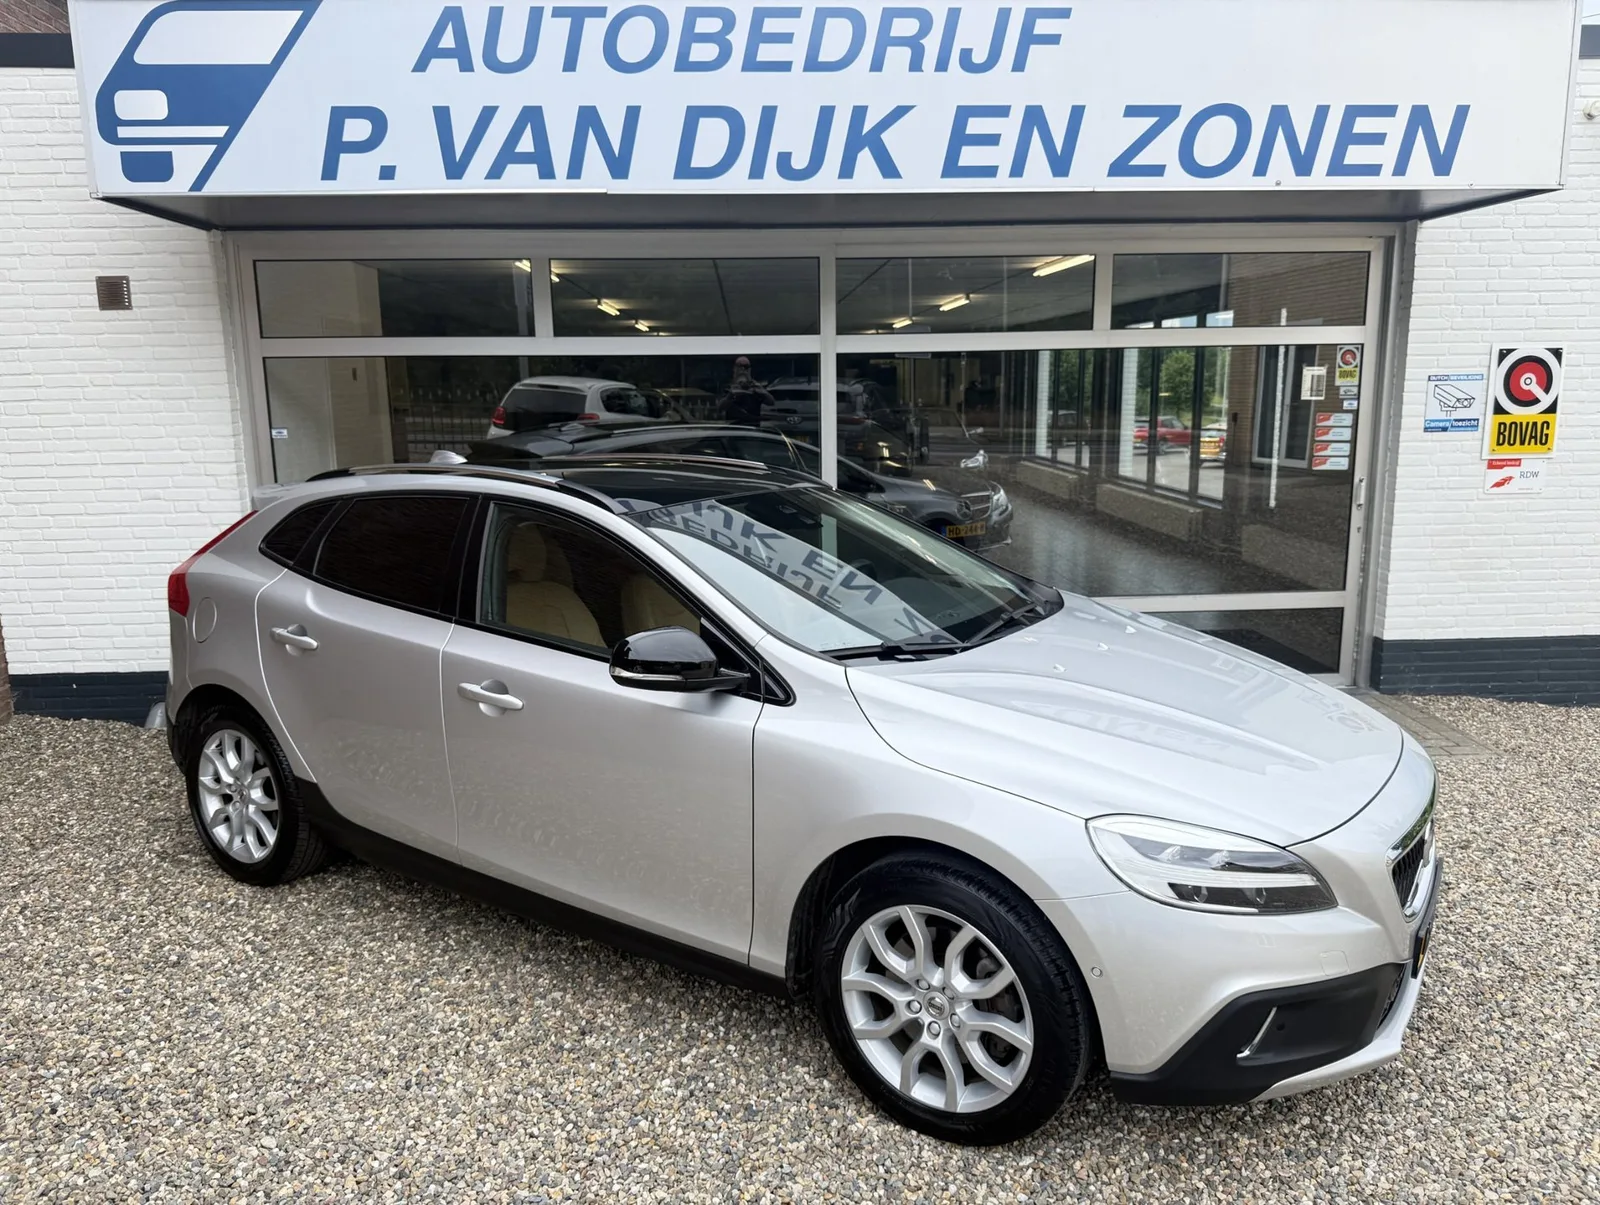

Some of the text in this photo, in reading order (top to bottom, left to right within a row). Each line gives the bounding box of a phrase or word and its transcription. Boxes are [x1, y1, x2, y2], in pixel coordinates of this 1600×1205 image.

[412, 6, 1072, 74] AUTOBEDRIJF
[322, 104, 1469, 182] P. VAN DIJK EN ZONEN
[1425, 419, 1478, 428] Camera toezicht
[1496, 420, 1550, 447] BOVAG
[1519, 470, 1539, 479] RDW
